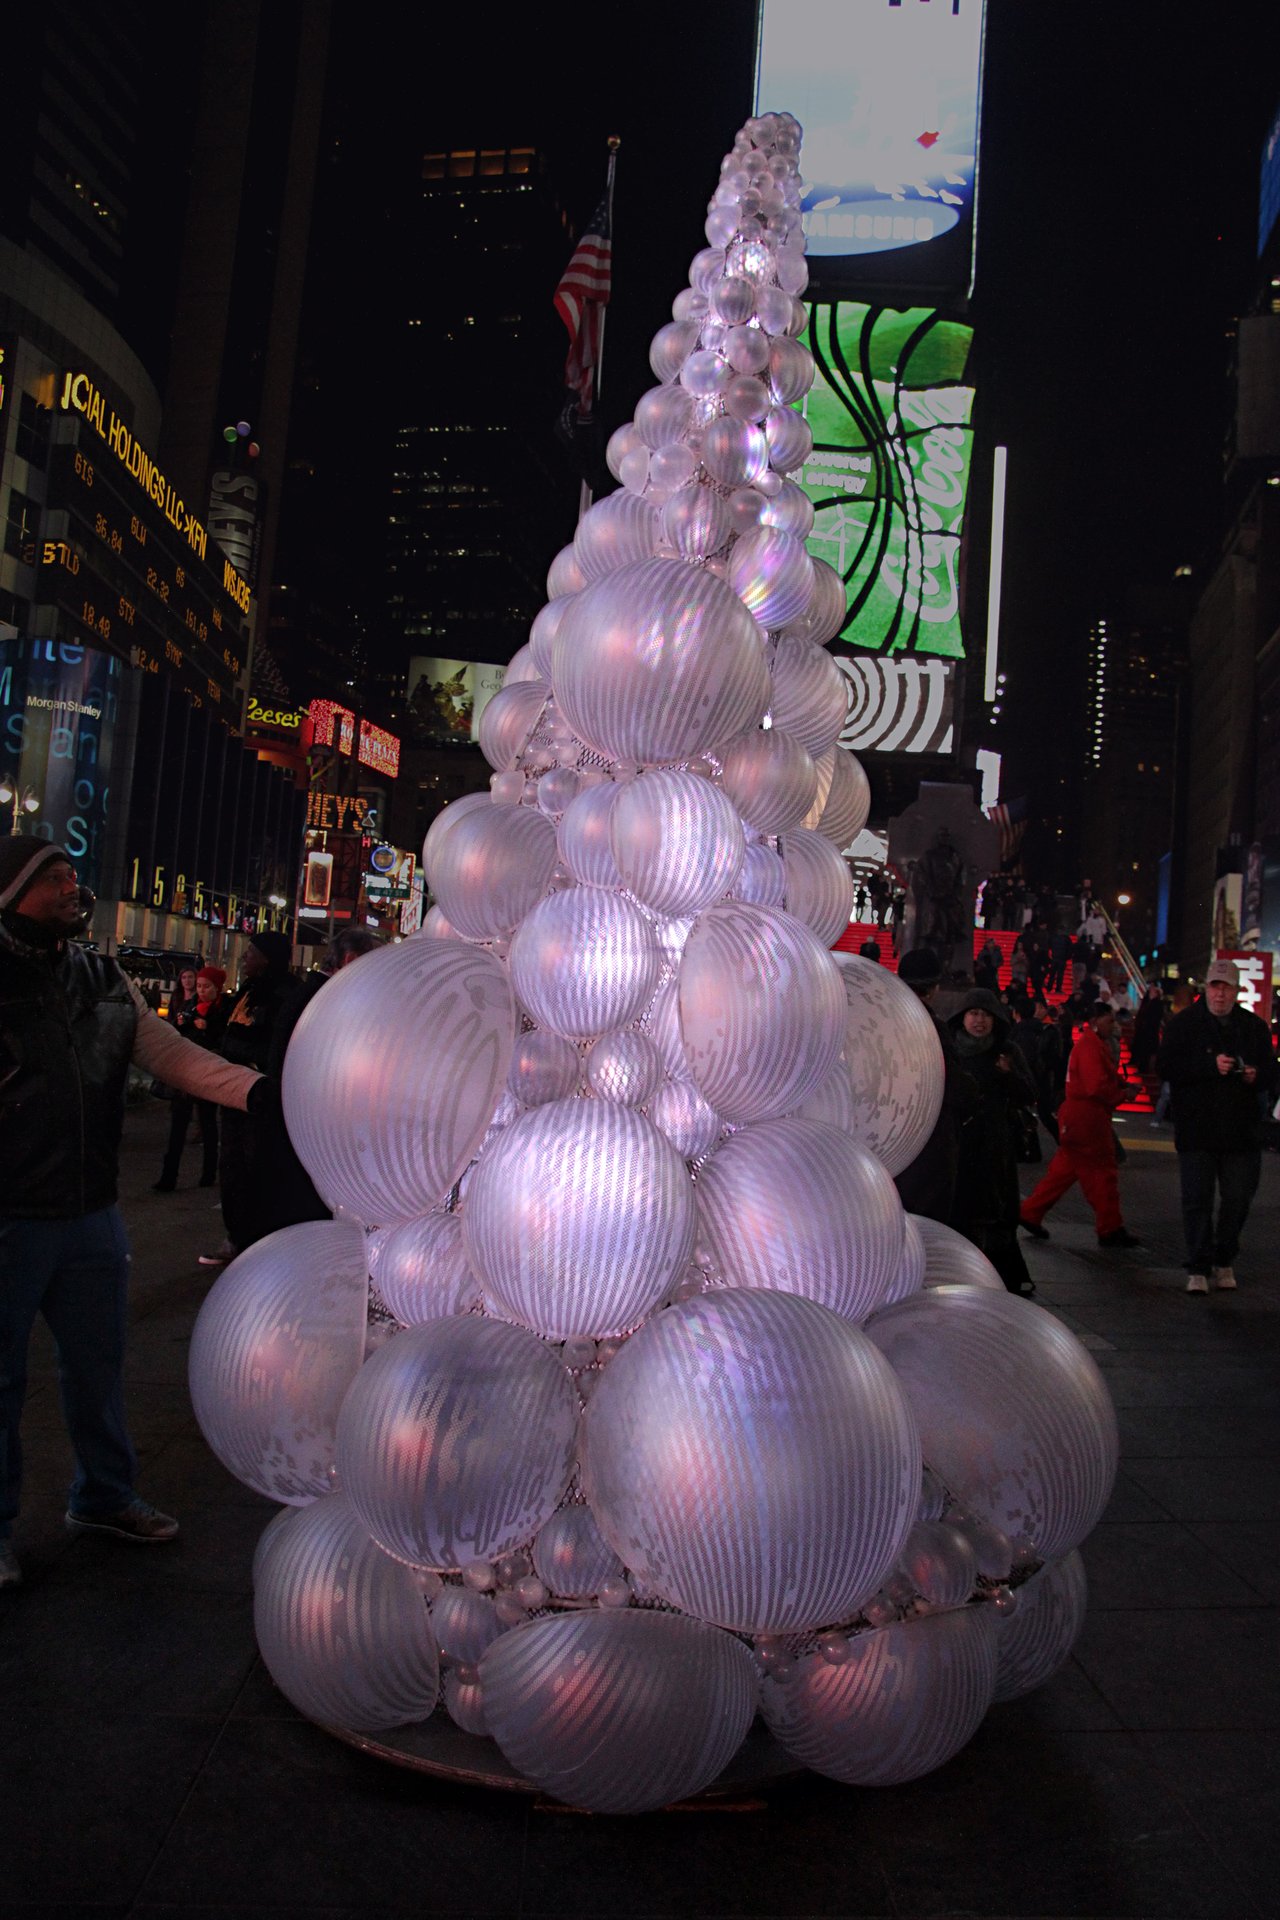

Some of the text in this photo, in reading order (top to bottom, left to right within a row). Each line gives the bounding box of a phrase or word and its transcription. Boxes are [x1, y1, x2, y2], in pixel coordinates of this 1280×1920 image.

[802, 212, 934, 242] AMSUNG
[75, 453, 94, 488] GIS
[108, 411, 166, 509] HOLDINGS
[165, 485, 185, 532] LLC
[27, 695, 66, 711] Morgan
[67, 700, 102, 720] Stanley
